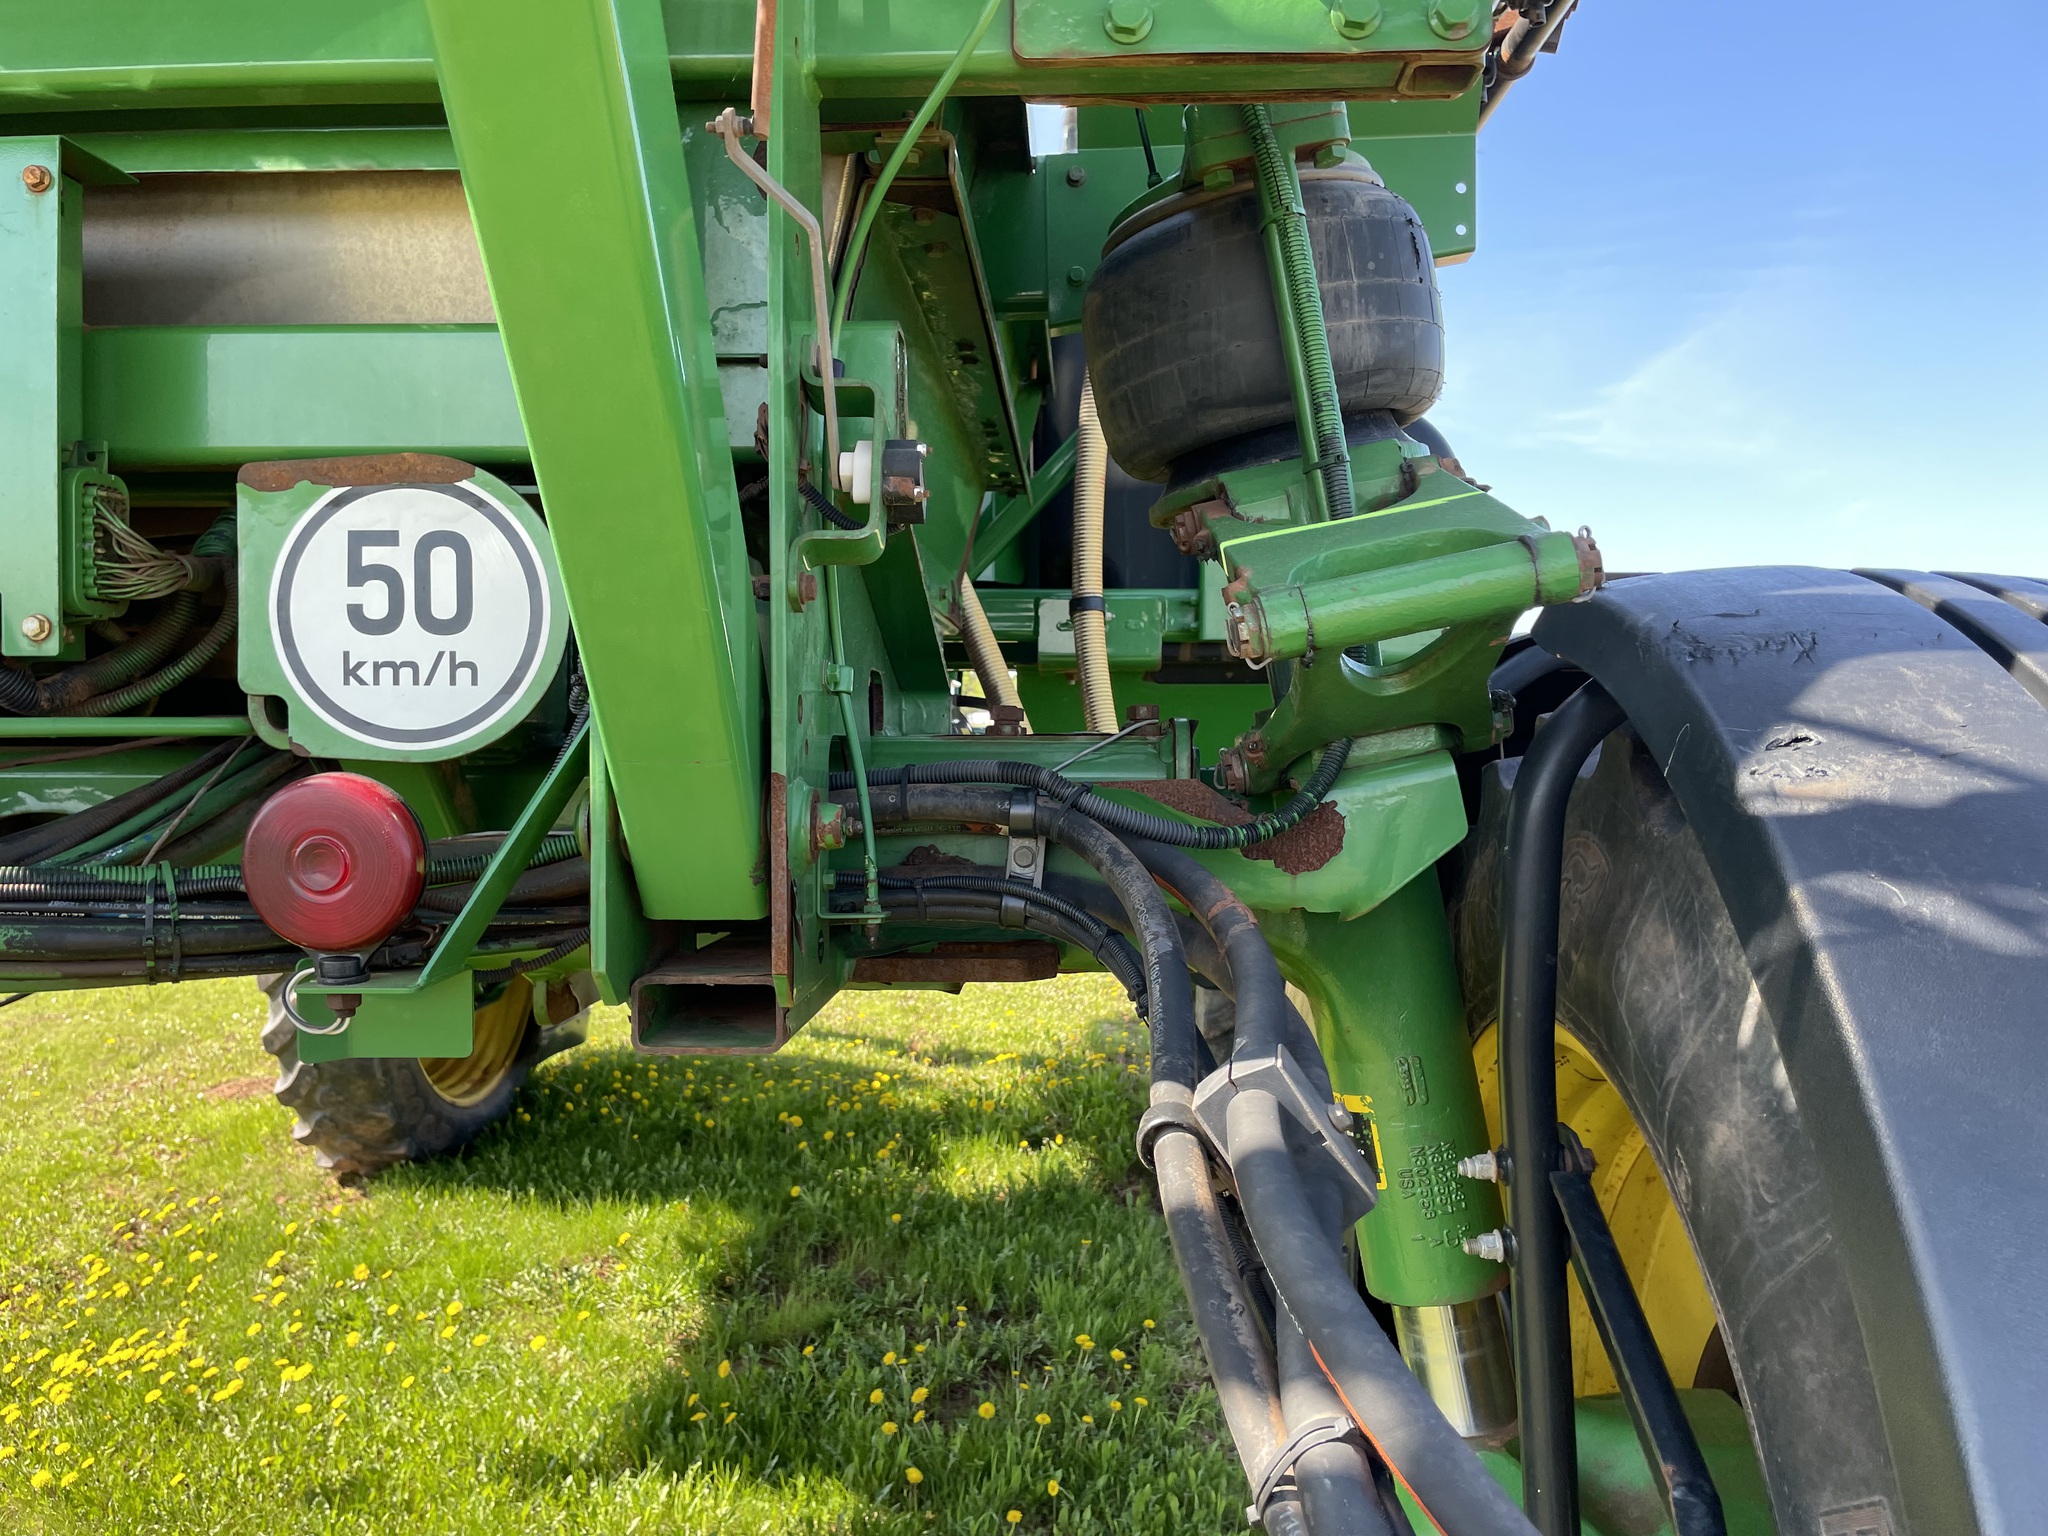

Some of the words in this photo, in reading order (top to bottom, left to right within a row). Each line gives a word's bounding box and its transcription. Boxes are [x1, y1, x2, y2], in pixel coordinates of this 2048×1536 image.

[346, 530, 474, 636] 50
[342, 650, 478, 686] km/h
[1110, 863, 1149, 929] MULTI-PURPOSE
[1146, 941, 1158, 965] INCH
[1152, 1002, 1163, 1022] 315
[1398, 1167, 1416, 1200] USA
[1410, 1145, 1436, 1220] N302558
[1426, 1144, 1454, 1214] N302557
